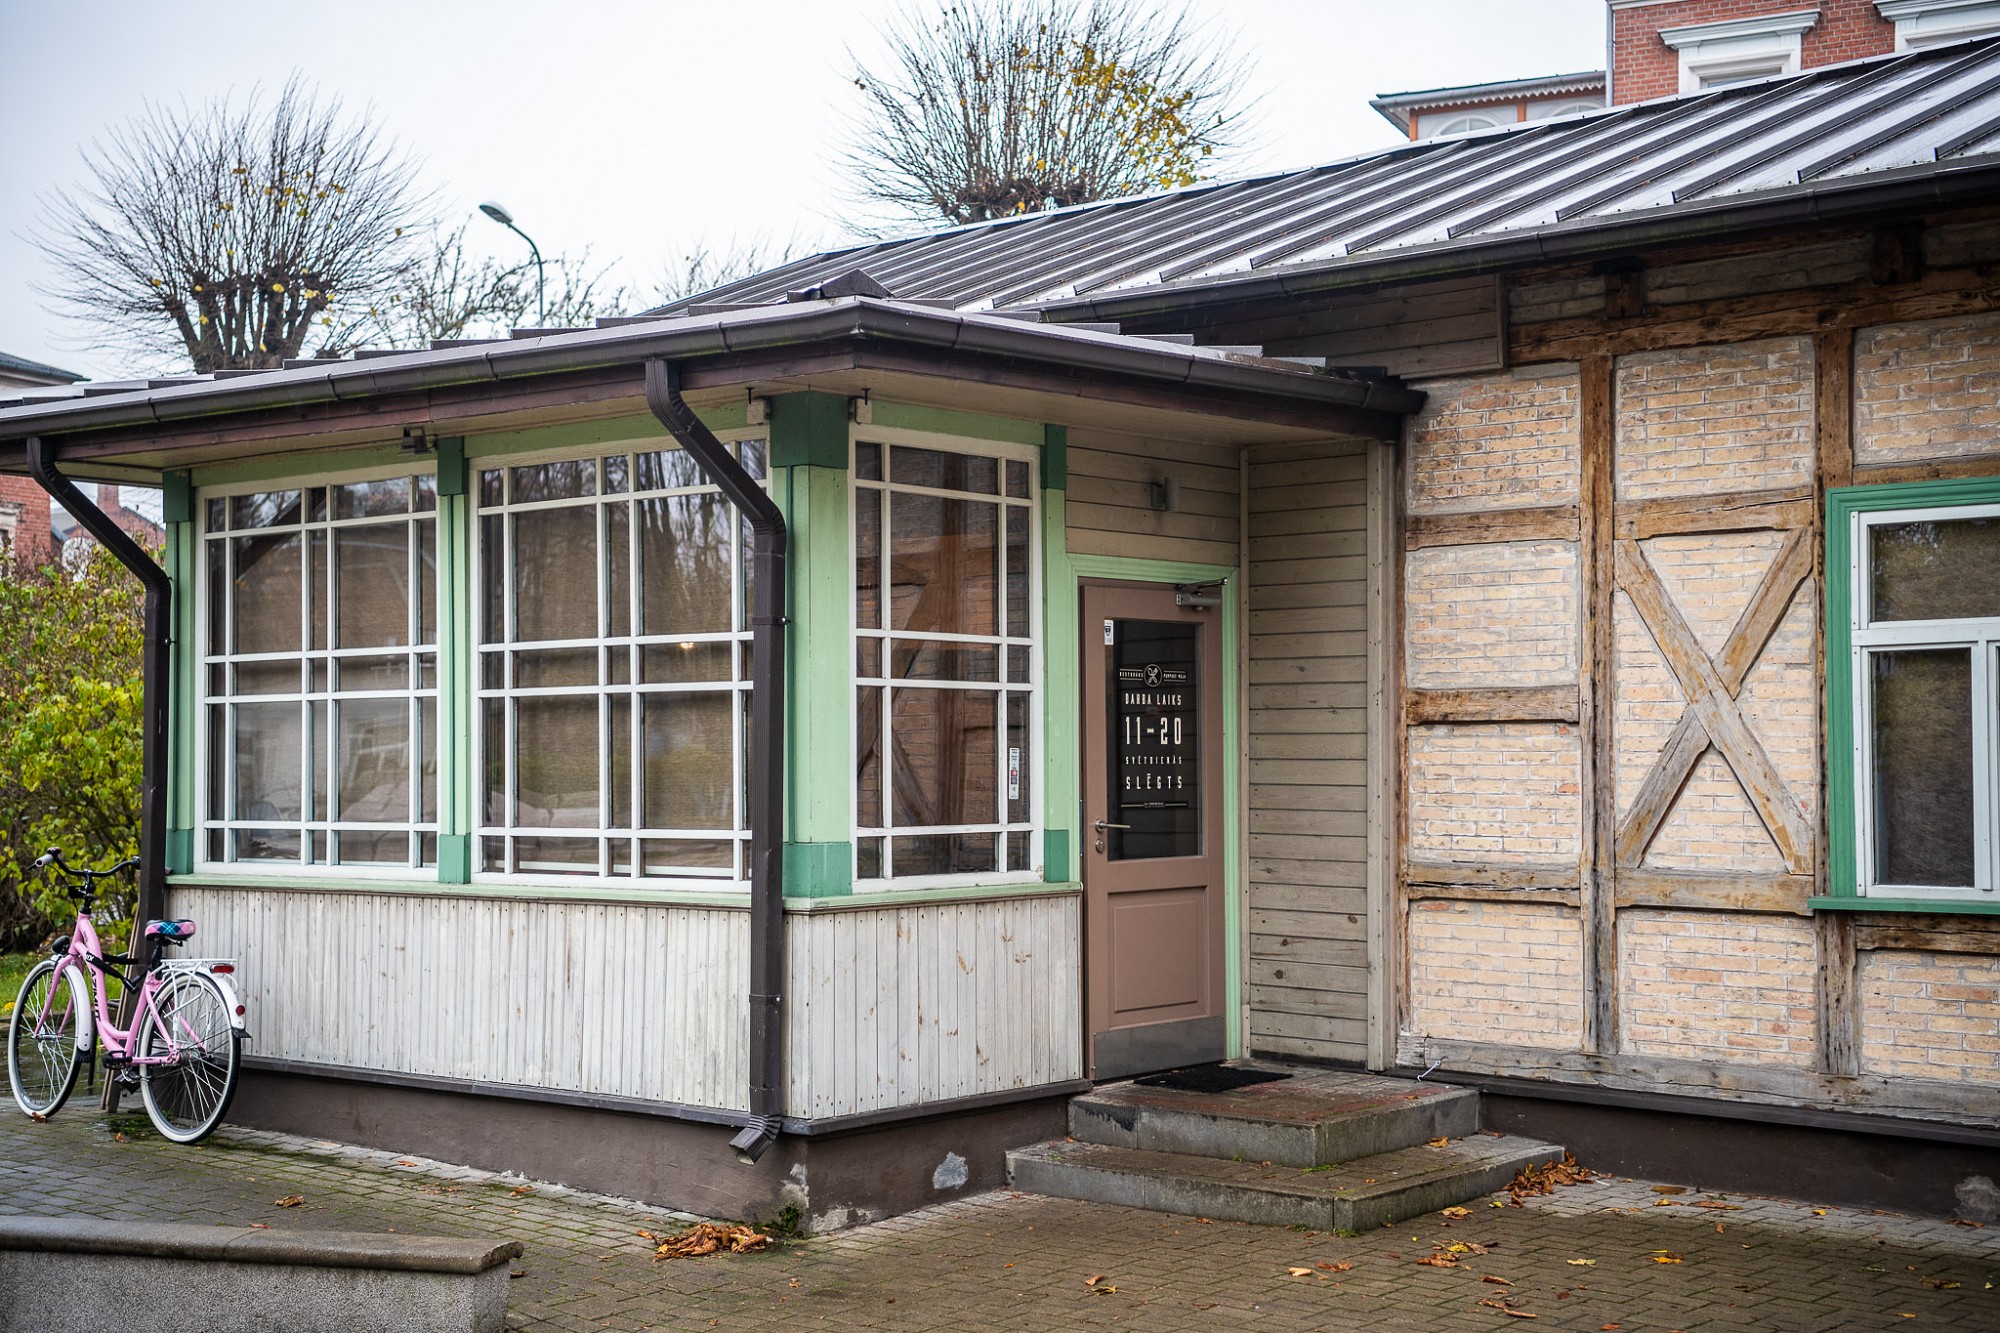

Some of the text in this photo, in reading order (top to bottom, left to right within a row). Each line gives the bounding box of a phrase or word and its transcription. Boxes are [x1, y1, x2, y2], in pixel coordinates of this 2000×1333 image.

[1125, 693, 1182, 706] DARBA LAIKS
[1126, 773, 1182, 790] SLĒGTS
[90, 967, 102, 1022] AZIMUT
